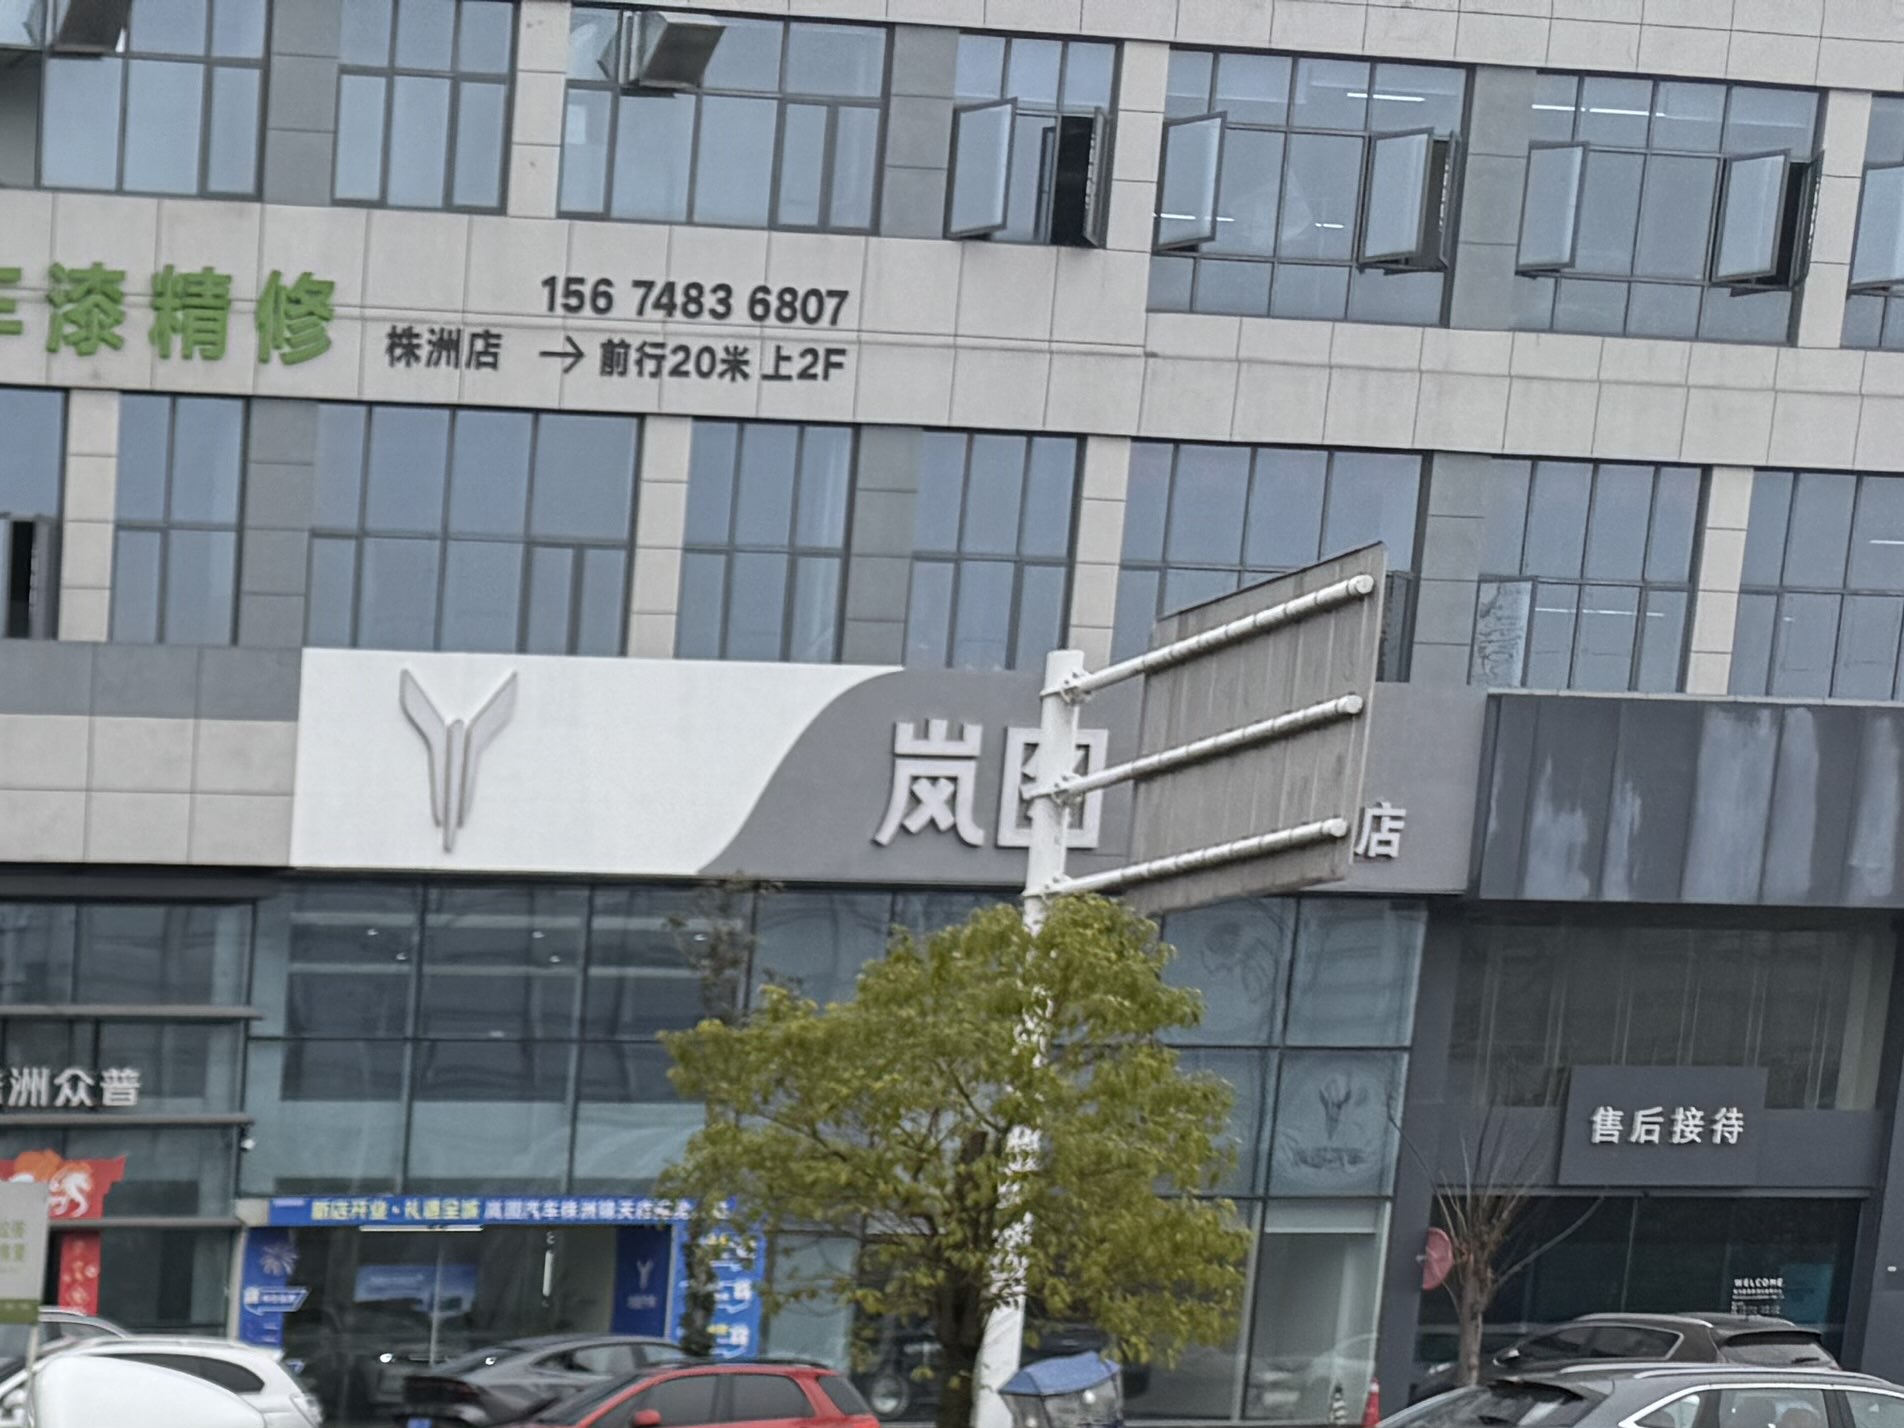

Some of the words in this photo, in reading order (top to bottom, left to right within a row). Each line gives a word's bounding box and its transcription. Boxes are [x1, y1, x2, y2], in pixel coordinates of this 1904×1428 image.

[540, 276, 614, 315] 156
[631, 280, 733, 321] 7483
[748, 285, 849, 326] 6807
[386, 325, 502, 371] 株洲店
[599, 338, 751, 382] 前行20米
[761, 344, 848, 382] 上2F
[1590, 1106, 1745, 1145] 售后接待
